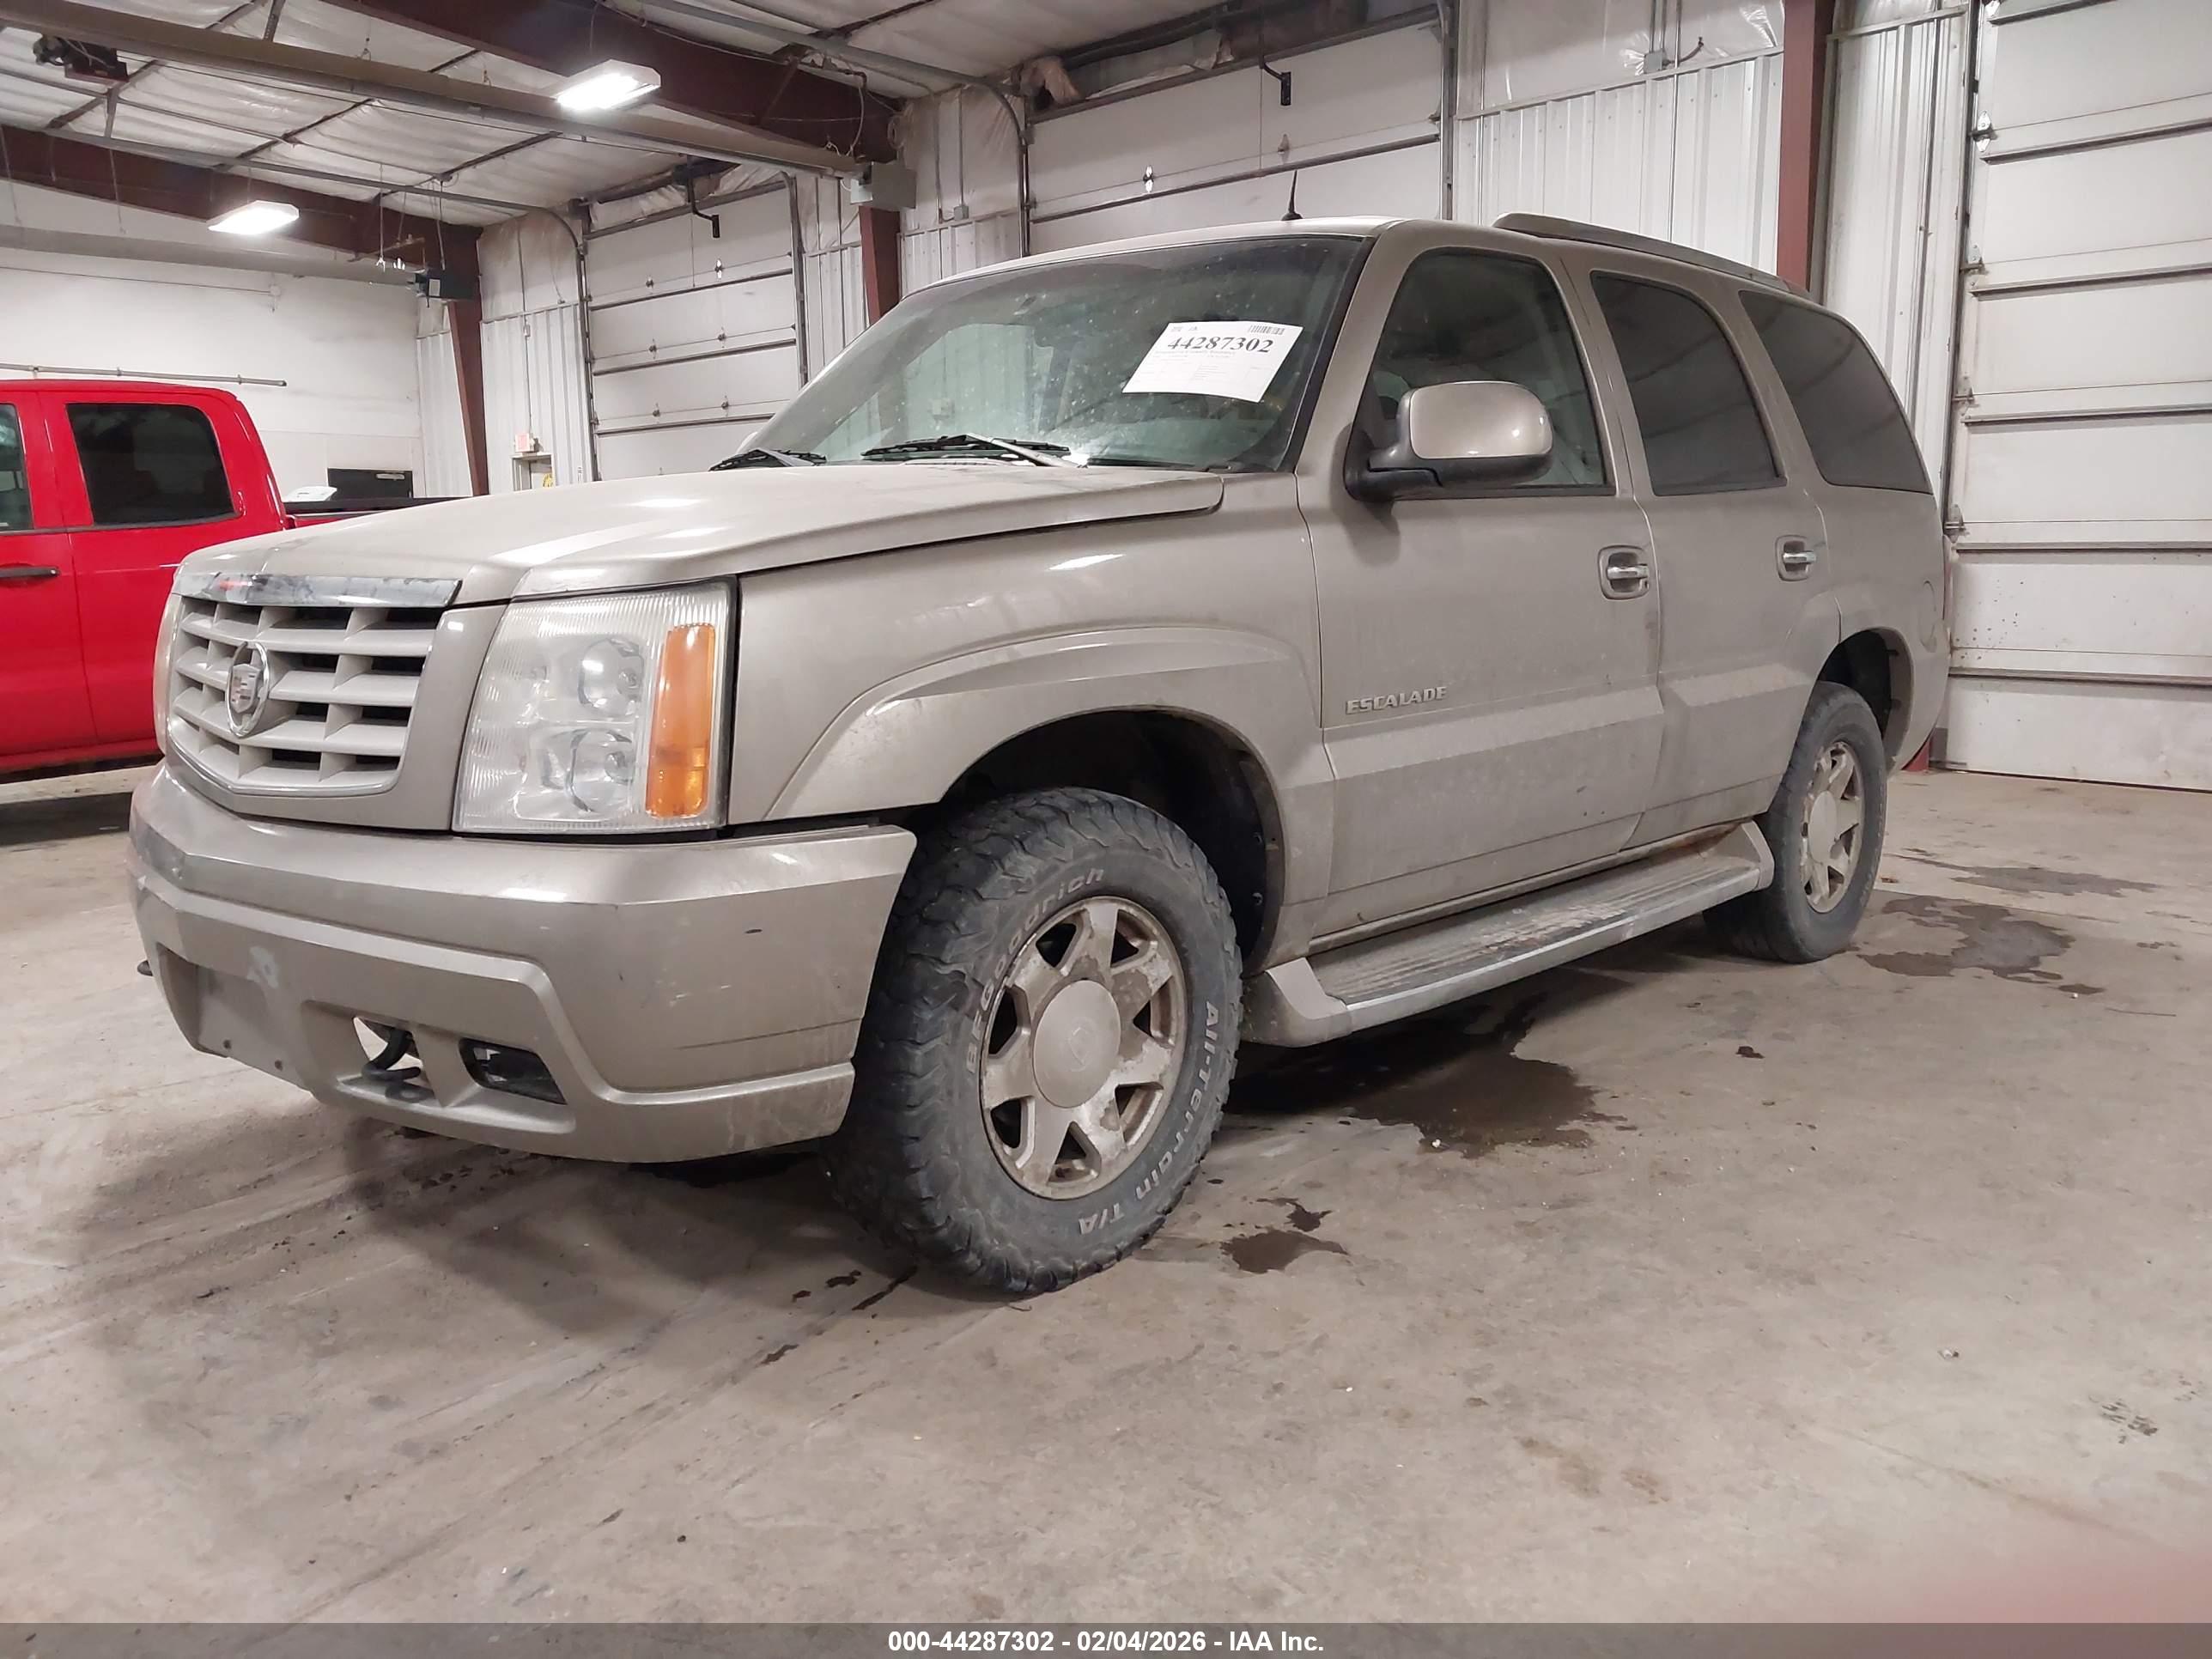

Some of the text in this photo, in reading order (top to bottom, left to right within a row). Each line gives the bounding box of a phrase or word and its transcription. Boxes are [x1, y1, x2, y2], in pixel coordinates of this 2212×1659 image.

[1168, 336, 1273, 353] 44287302
[1346, 686, 1448, 714] ESCALADE
[967, 868, 1104, 1073] BFGoodrich
[1079, 1001, 1218, 1236] All-Terrain T/A
